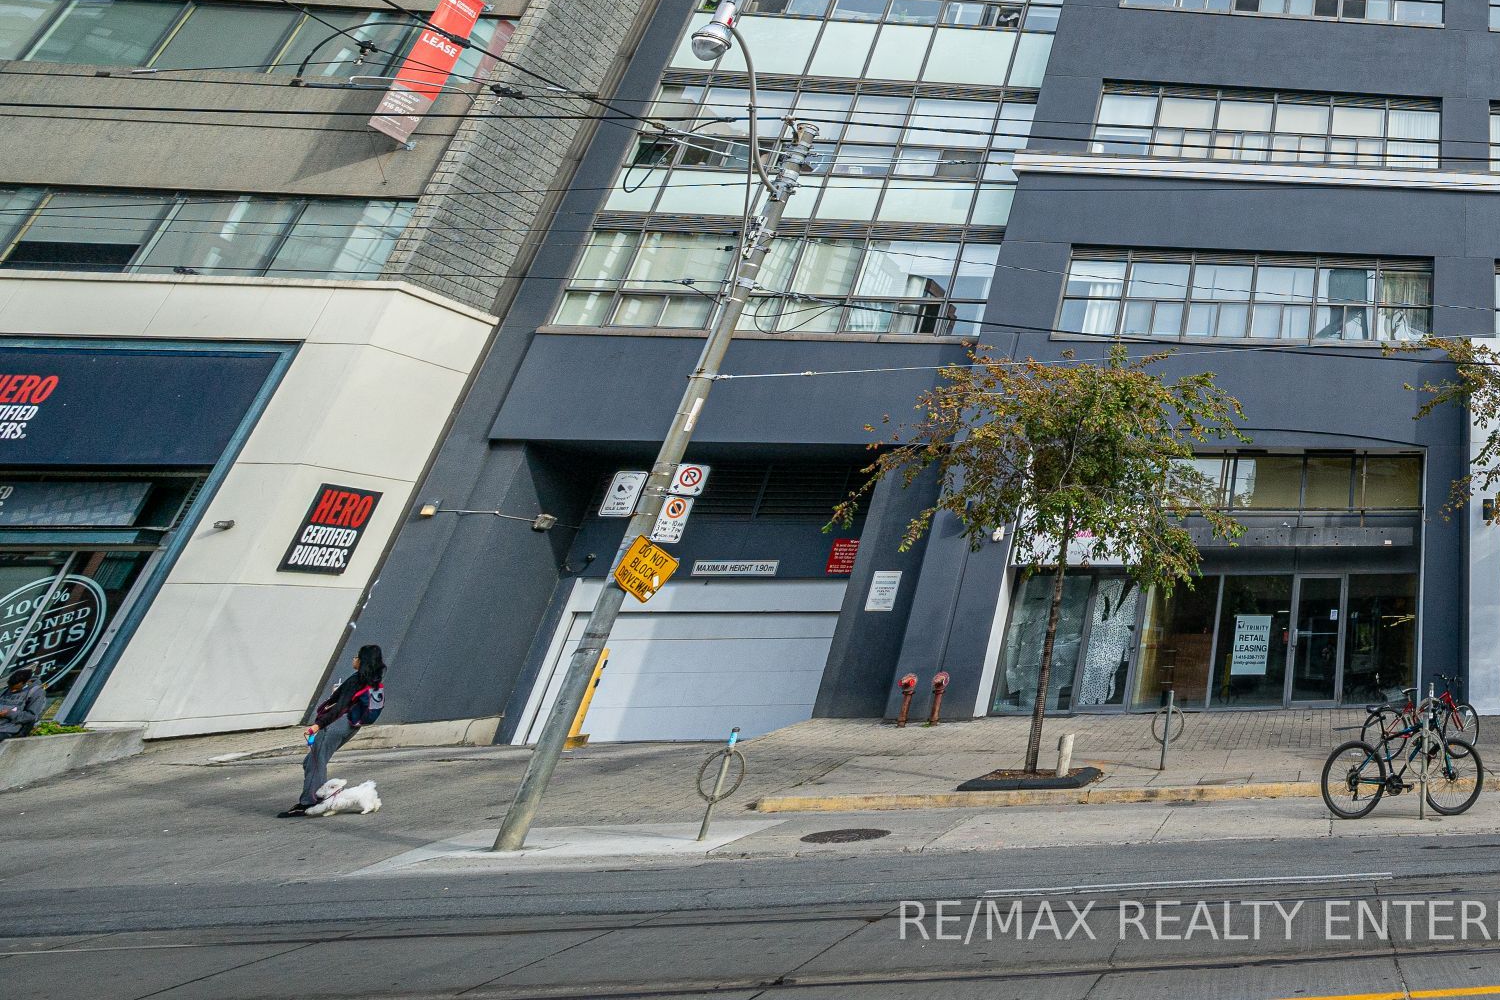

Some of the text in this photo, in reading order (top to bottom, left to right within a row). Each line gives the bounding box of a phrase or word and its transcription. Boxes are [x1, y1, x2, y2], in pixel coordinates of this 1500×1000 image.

[422, 33, 458, 58] LEASE
[311, 489, 374, 528] HERO
[301, 525, 358, 547] CERTIFIED
[287, 545, 349, 568] BURGERS.
[638, 543, 669, 570] DO NOT
[696, 564, 729, 572] MAXIMUM
[729, 564, 754, 572] HEIGHT
[629, 556, 658, 582] BLOCK
[1234, 644, 1267, 652] LEASING
[1238, 634, 1266, 642] RETAIL
